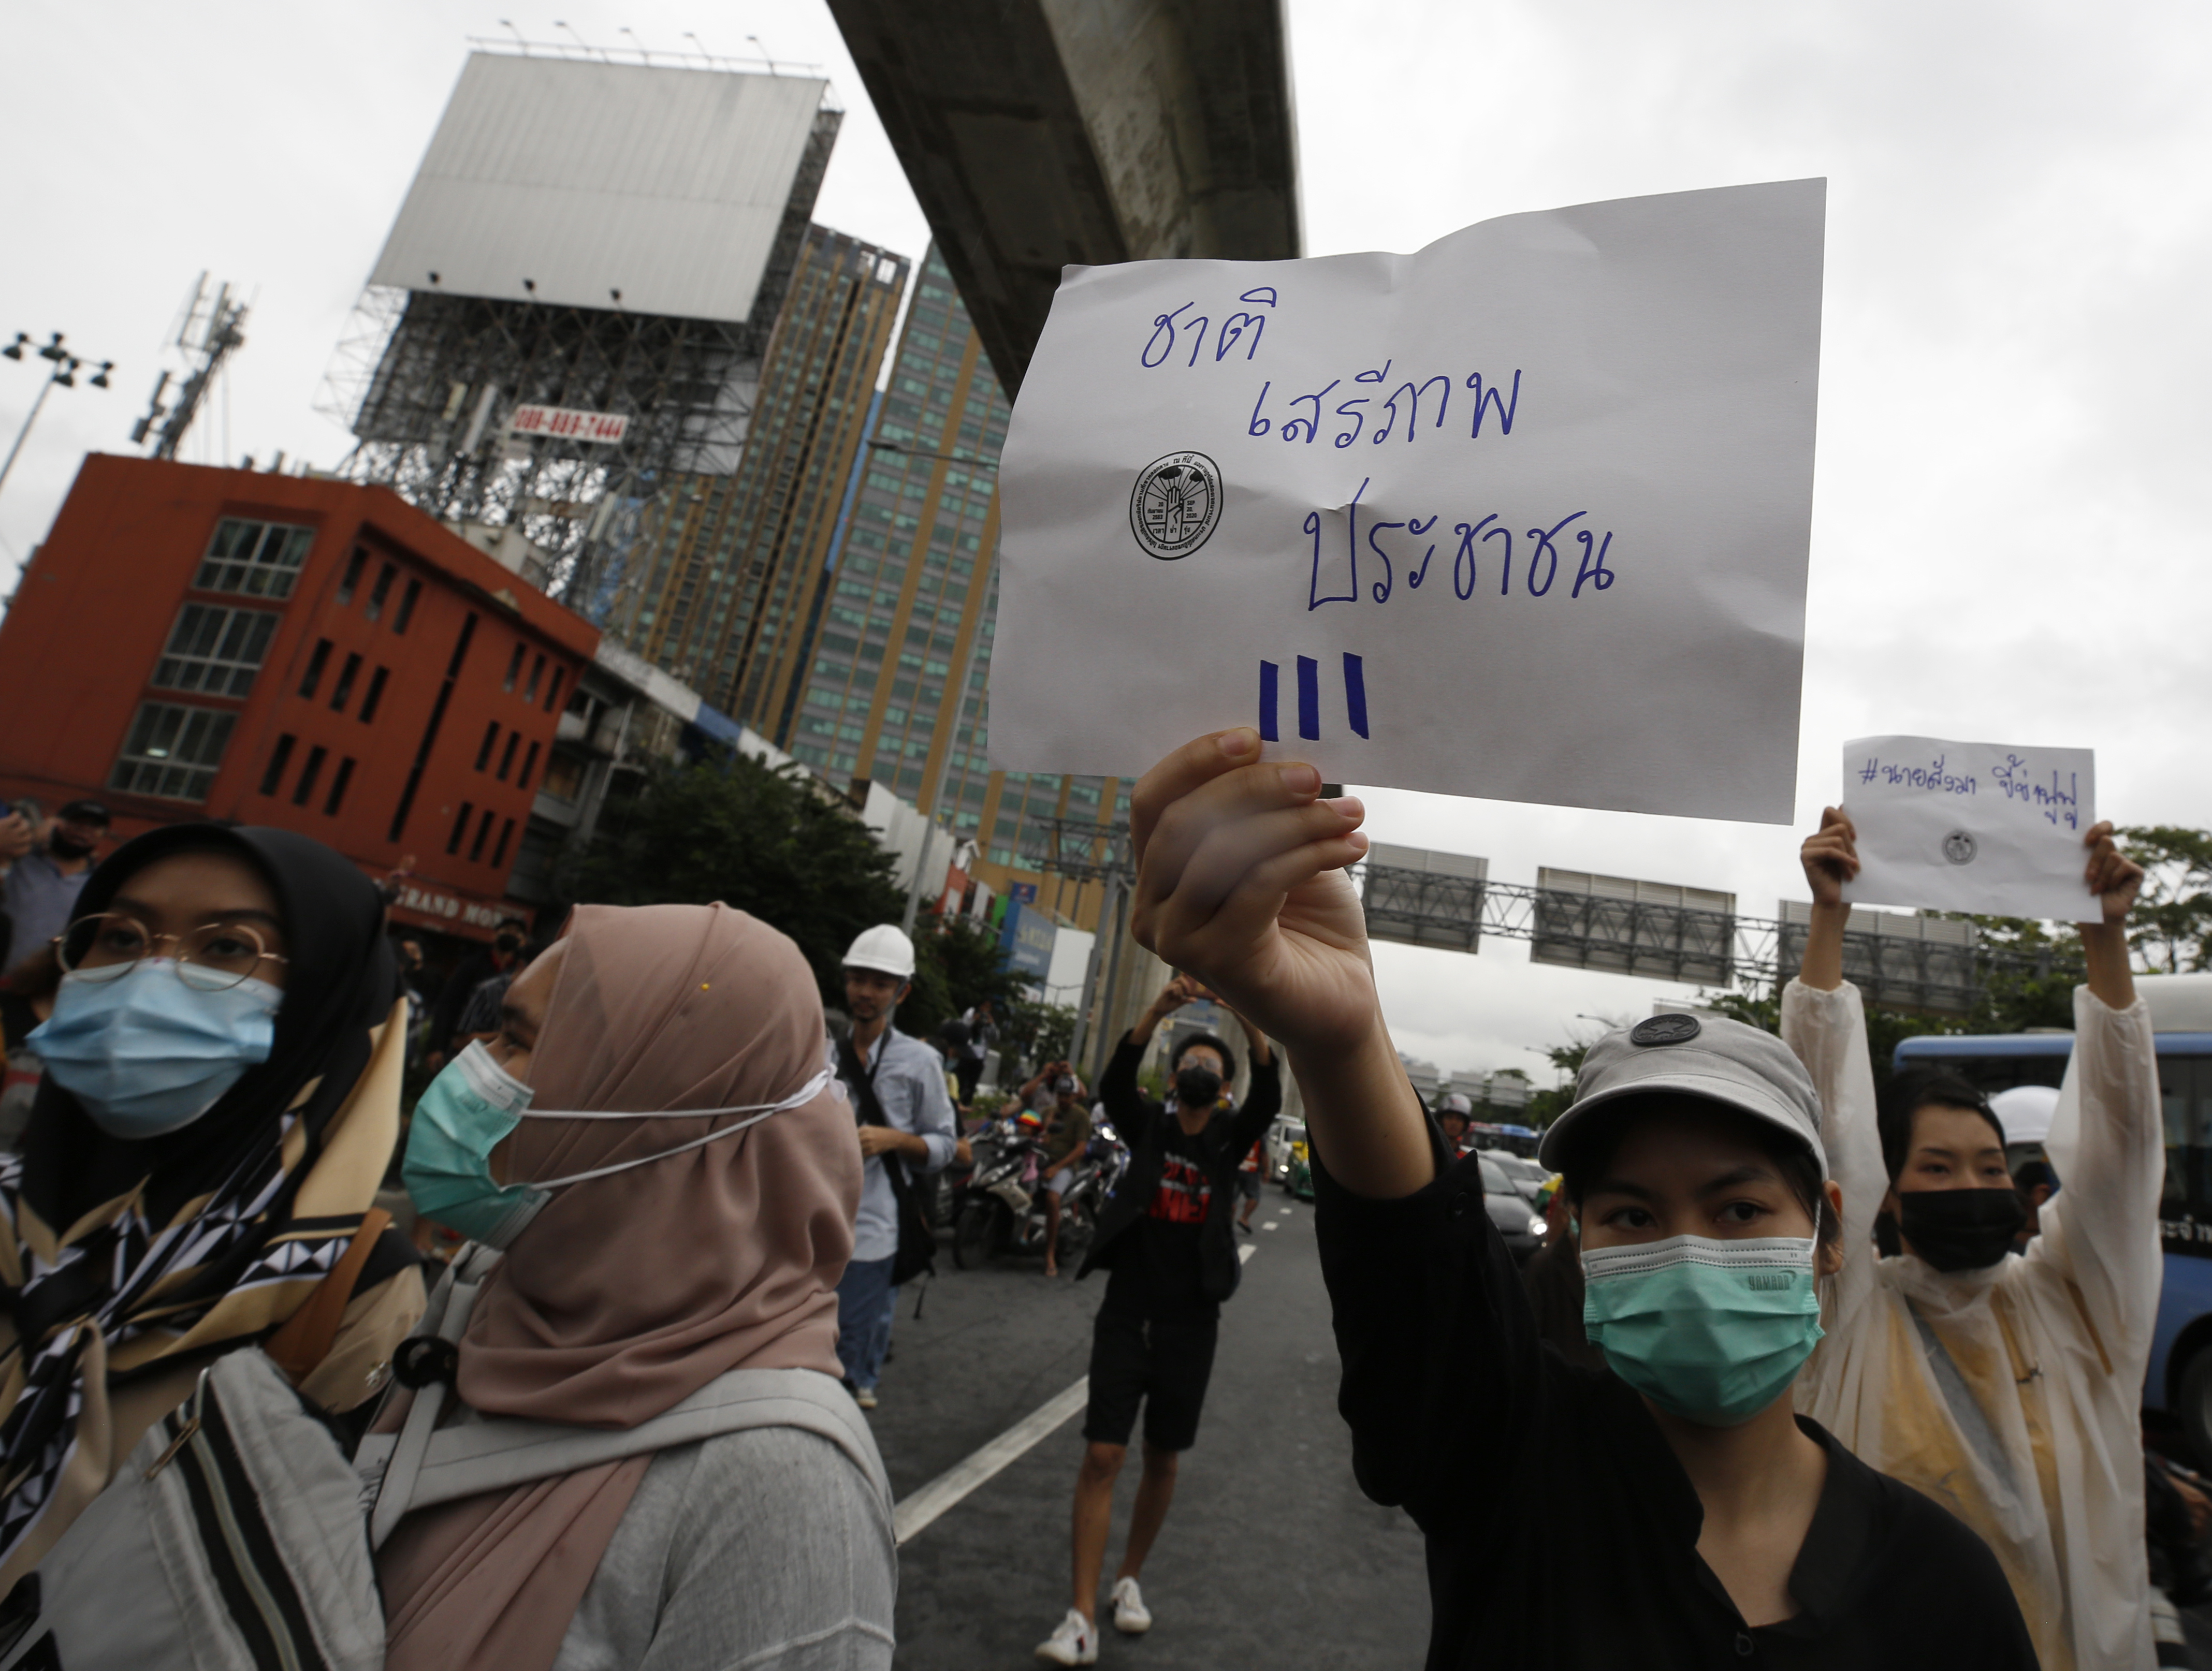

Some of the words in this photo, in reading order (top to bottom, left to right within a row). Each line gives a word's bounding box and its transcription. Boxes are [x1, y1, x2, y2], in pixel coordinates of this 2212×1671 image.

[1141, 286, 1277, 369] ชาติ
[1247, 359, 1522, 449] เสรีภาพ
[1303, 477, 1615, 612] ประชาชน
